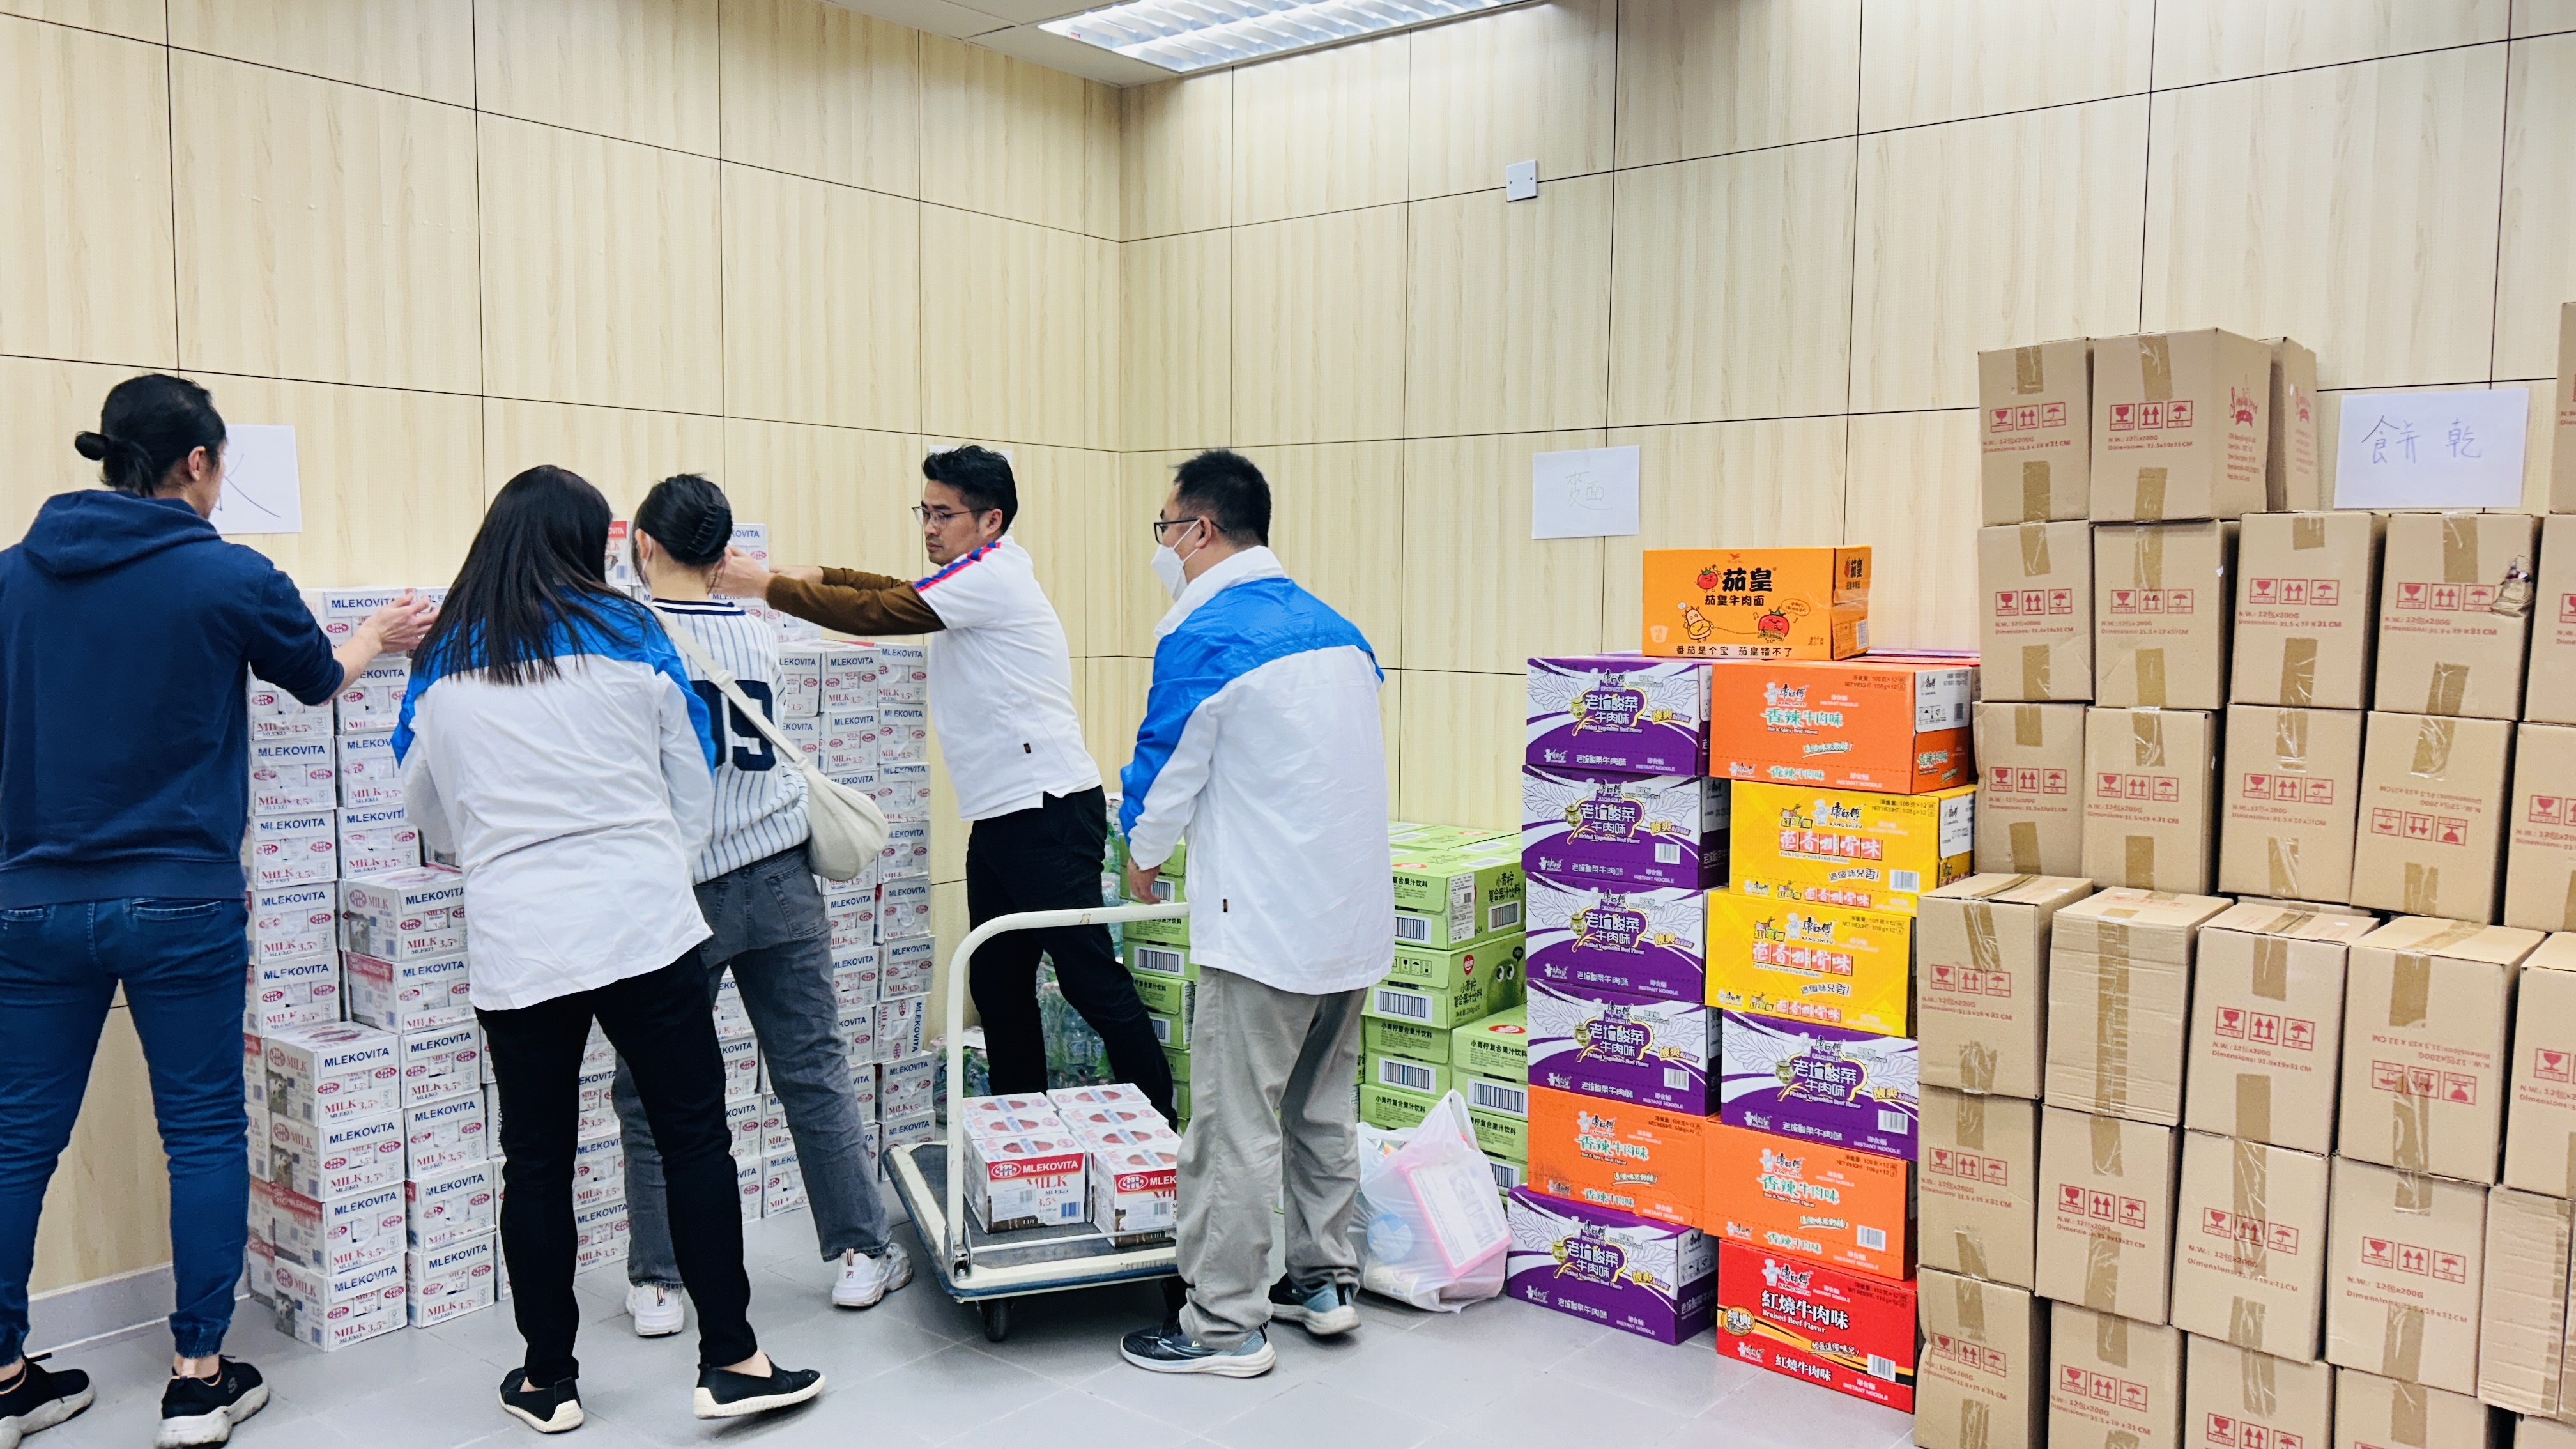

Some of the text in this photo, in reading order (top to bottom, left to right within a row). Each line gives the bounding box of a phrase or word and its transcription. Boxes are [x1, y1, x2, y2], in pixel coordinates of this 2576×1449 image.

[1722, 568, 1772, 592] 茄皇
[1705, 595, 1764, 606] 茄皇牛肉面
[882, 648, 923, 658] MLEKOVITA
[1676, 645, 1728, 655] 番茄是个宝
[779, 657, 816, 666] LEKOVITA
[831, 657, 873, 666] MLEKOVITA
[829, 693, 849, 702] MILK
[834, 716, 874, 726] MLEKOVITA
[1595, 712, 1629, 724] 牛肉味
[1765, 709, 1843, 727] 香辣牛肉味
[258, 746, 325, 756] MLEKOVITA
[347, 739, 391, 749] MLEKOV
[260, 818, 325, 830] MLEKOVITA
[1591, 822, 1626, 834] 牛肉味
[889, 830, 924, 839] LEKOVITA
[262, 891, 326, 907] MLEKOVITA
[406, 887, 464, 905] MLEKOVITA
[889, 887, 926, 897] MLEKOVITA
[831, 895, 871, 908] MLEKOVITA
[407, 937, 438, 949] MILK
[1595, 930, 1630, 944] 牛肉味
[892, 944, 930, 956] MLEKOVITA
[403, 961, 464, 978] MLEKOVITA
[833, 956, 873, 969] MLEKOVITA
[264, 964, 329, 980] MLEKOVITA
[912, 1002, 922, 1052] MLEKOVITA
[411, 1032, 471, 1052] MLEKOVITA
[721, 1043, 752, 1055] KOVITA
[1600, 1041, 1635, 1057] 牛肉味
[325, 1047, 390, 1068] MLEKOVITA
[2212, 1050, 2255, 1062] Dimensions:
[889, 1062, 928, 1075] MLEKOVITA
[579, 1071, 617, 1085] EKOVITA
[1805, 1079, 1845, 1097] 牛肉味
[325, 1100, 356, 1114] MILK
[1643, 1098, 1662, 1106] INSTANT
[415, 1101, 476, 1122] MLEKOVITA
[726, 1104, 756, 1117] KOVITA
[330, 1121, 395, 1144] MLEKOVITA
[889, 1120, 930, 1135] MLEKOVITA
[1471, 1117, 1516, 1135] 柠复合果汁饮料
[578, 1137, 621, 1154] MLEKOVI
[1577, 1136, 1649, 1160] 香辣牛肉味
[1854, 1140, 1901, 1154] INSTANT NOODLE
[770, 1154, 798, 1167] MLEKO
[1023, 1160, 1078, 1174] MLEKOVITA
[331, 1174, 362, 1188] MILK
[425, 1174, 484, 1196] MLEKOVITA
[1761, 1176, 1839, 1204] 香辣牛肉味
[335, 1192, 397, 1216] MLEKOVITA
[578, 1203, 628, 1224] MLEKOVITA
[429, 1243, 487, 1269] MLEKOVITA
[577, 1249, 602, 1262] MILK
[1577, 1260, 1609, 1278] 牛肉味
[335, 1266, 397, 1292] MLEKOVITA
[1761, 1290, 1849, 1330] 紅燒牛肉味
[1616, 1320, 1655, 1335] INSTANT NOODLE
[1763, 1310, 1825, 1333] Braised Beef Flavor
[335, 1322, 366, 1339] MILK
[1775, 1354, 1831, 1381] 紅燒牛肉味
